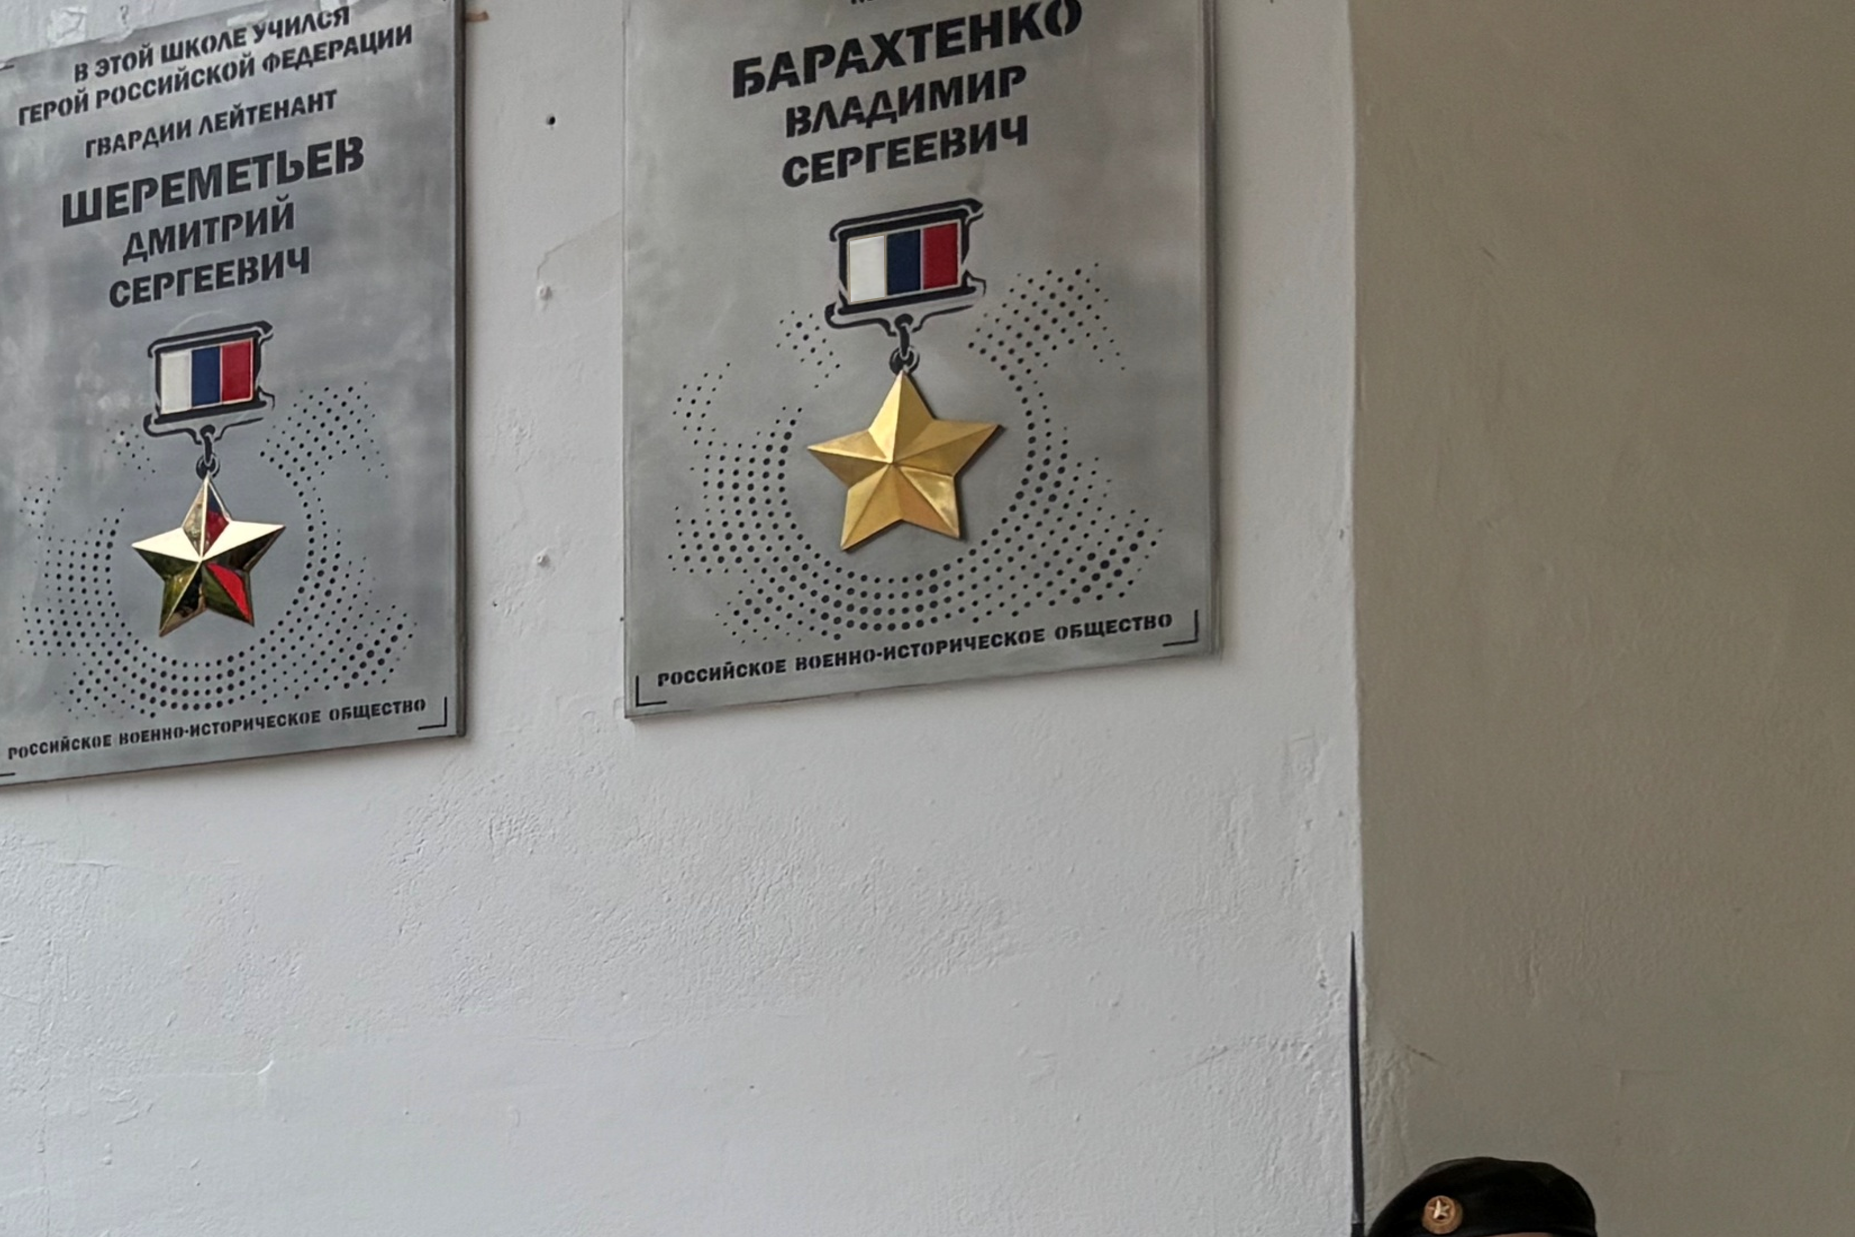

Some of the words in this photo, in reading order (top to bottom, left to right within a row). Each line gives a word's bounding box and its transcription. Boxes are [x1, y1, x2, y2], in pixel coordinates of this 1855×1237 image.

[19, 87, 88, 126] ГЕРОЙ
[96, 52, 254, 109] РОССИЙСКОЙ
[262, 24, 412, 73] ФЕДЕРАЦИИ
[75, 63, 88, 83] В
[95, 42, 153, 77] ЭТОЙ
[161, 27, 247, 63] ШКОЛЕ
[252, 6, 349, 43] УЧИЛСЯ
[733, 0, 1082, 99] БАРАХТЕНКО
[86, 119, 191, 158] ГВАРДИИ
[199, 89, 337, 135] ЛЕЙТЕНАНТ
[786, 66, 1026, 138] ВЛАДИМИР
[63, 136, 363, 228] ШЕРЕМЕТЬЕВ
[782, 115, 1027, 187] СЕРГЕЕВИЧ
[123, 194, 293, 266] ДМИТРИЙ
[110, 247, 309, 308] СЕРГЕЕВИЧ
[658, 659, 786, 687] РОССИЙСКОЕ
[796, 628, 1045, 671] ВОЕННО-ИСТОРИЧЕСКОЕ
[1055, 614, 1172, 639] ОБЩЕСТВО
[8, 735, 111, 760] РОССИЙСКОЕ
[119, 710, 320, 745] ВОЕННО-ИСТОРИЧЕСКОЕ
[329, 699, 425, 721] ОБЩЕСТВО
